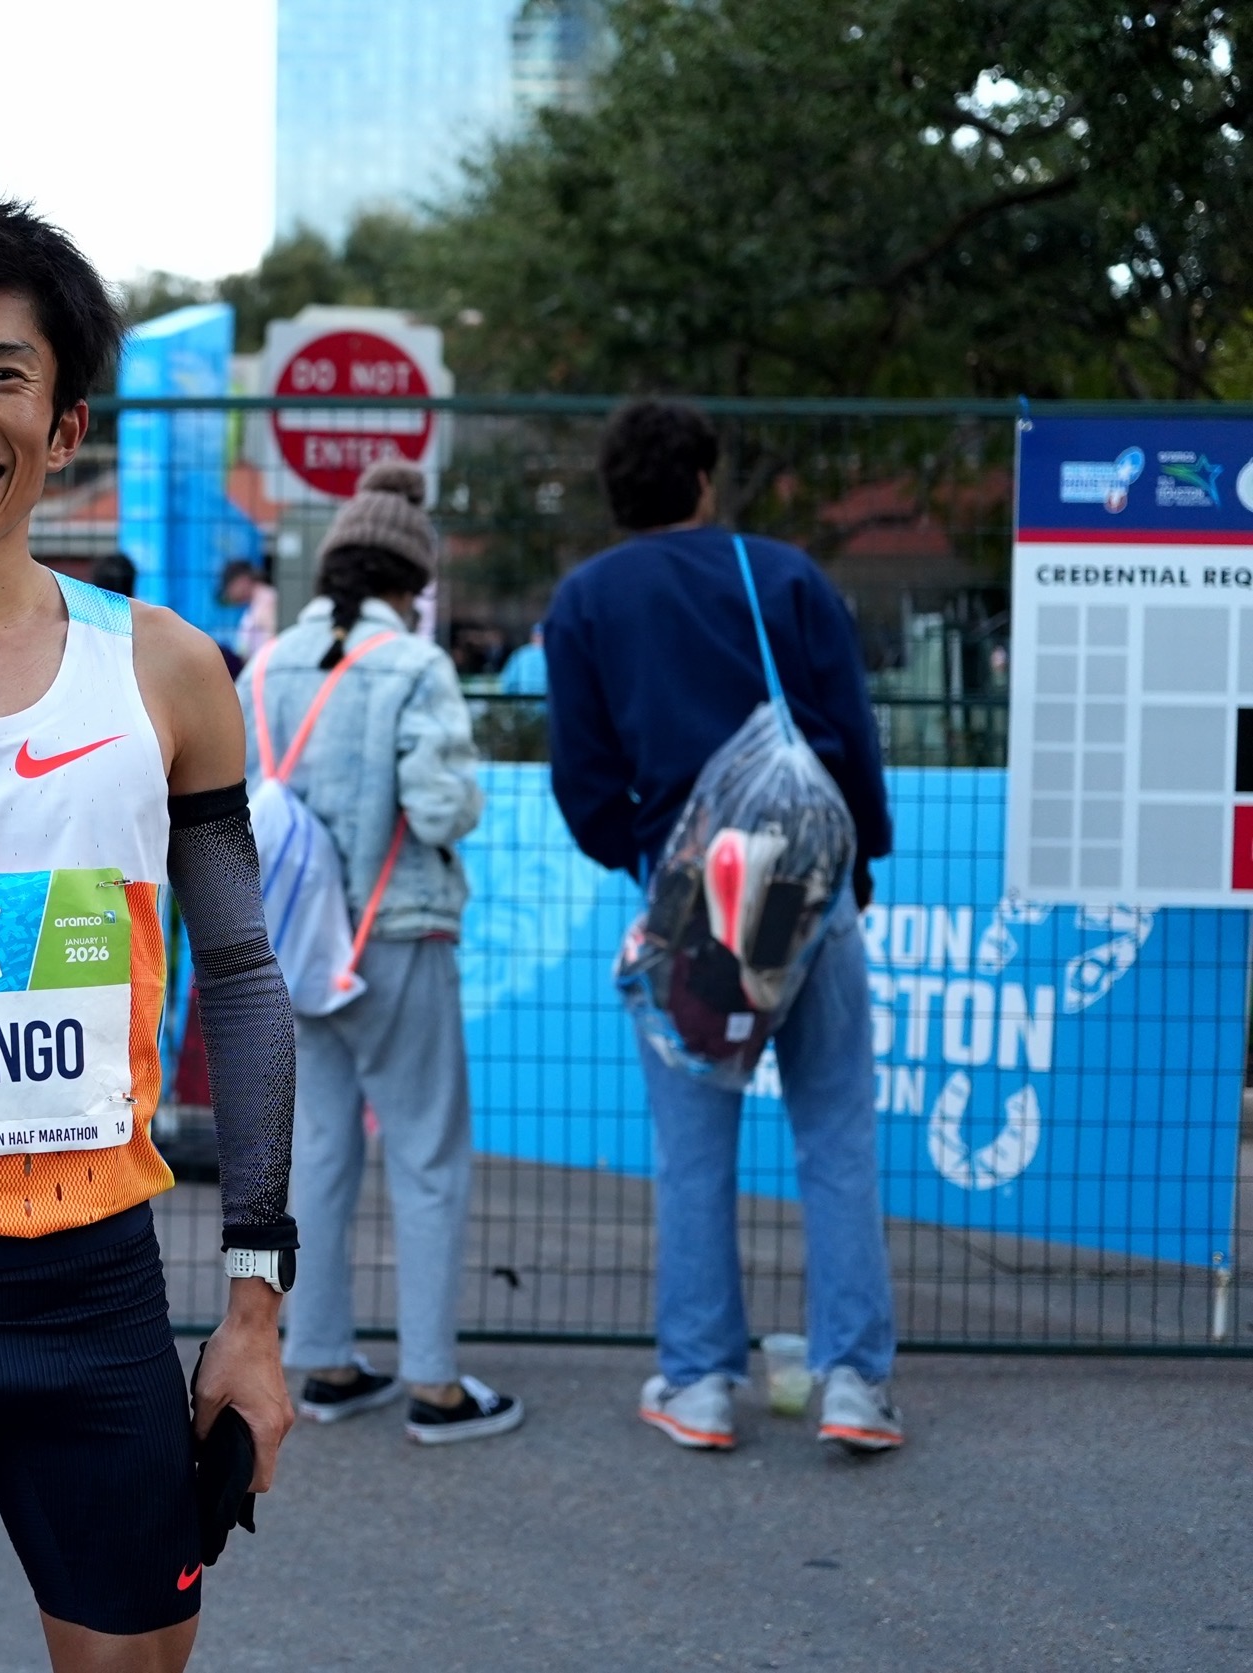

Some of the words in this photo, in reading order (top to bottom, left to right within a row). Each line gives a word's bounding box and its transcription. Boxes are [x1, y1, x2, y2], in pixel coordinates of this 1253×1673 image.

[291, 358, 337, 392] DO
[349, 360, 410, 394] NOT
[1036, 564, 1190, 587] CREDENTIAL
[54, 916, 102, 928] aramco
[64, 937, 98, 946] JANUARY
[64, 945, 110, 963] 2026
[8, 1130, 35, 1146] HALF
[38, 1126, 99, 1143] MARATHON
[115, 1121, 126, 1135] 14
